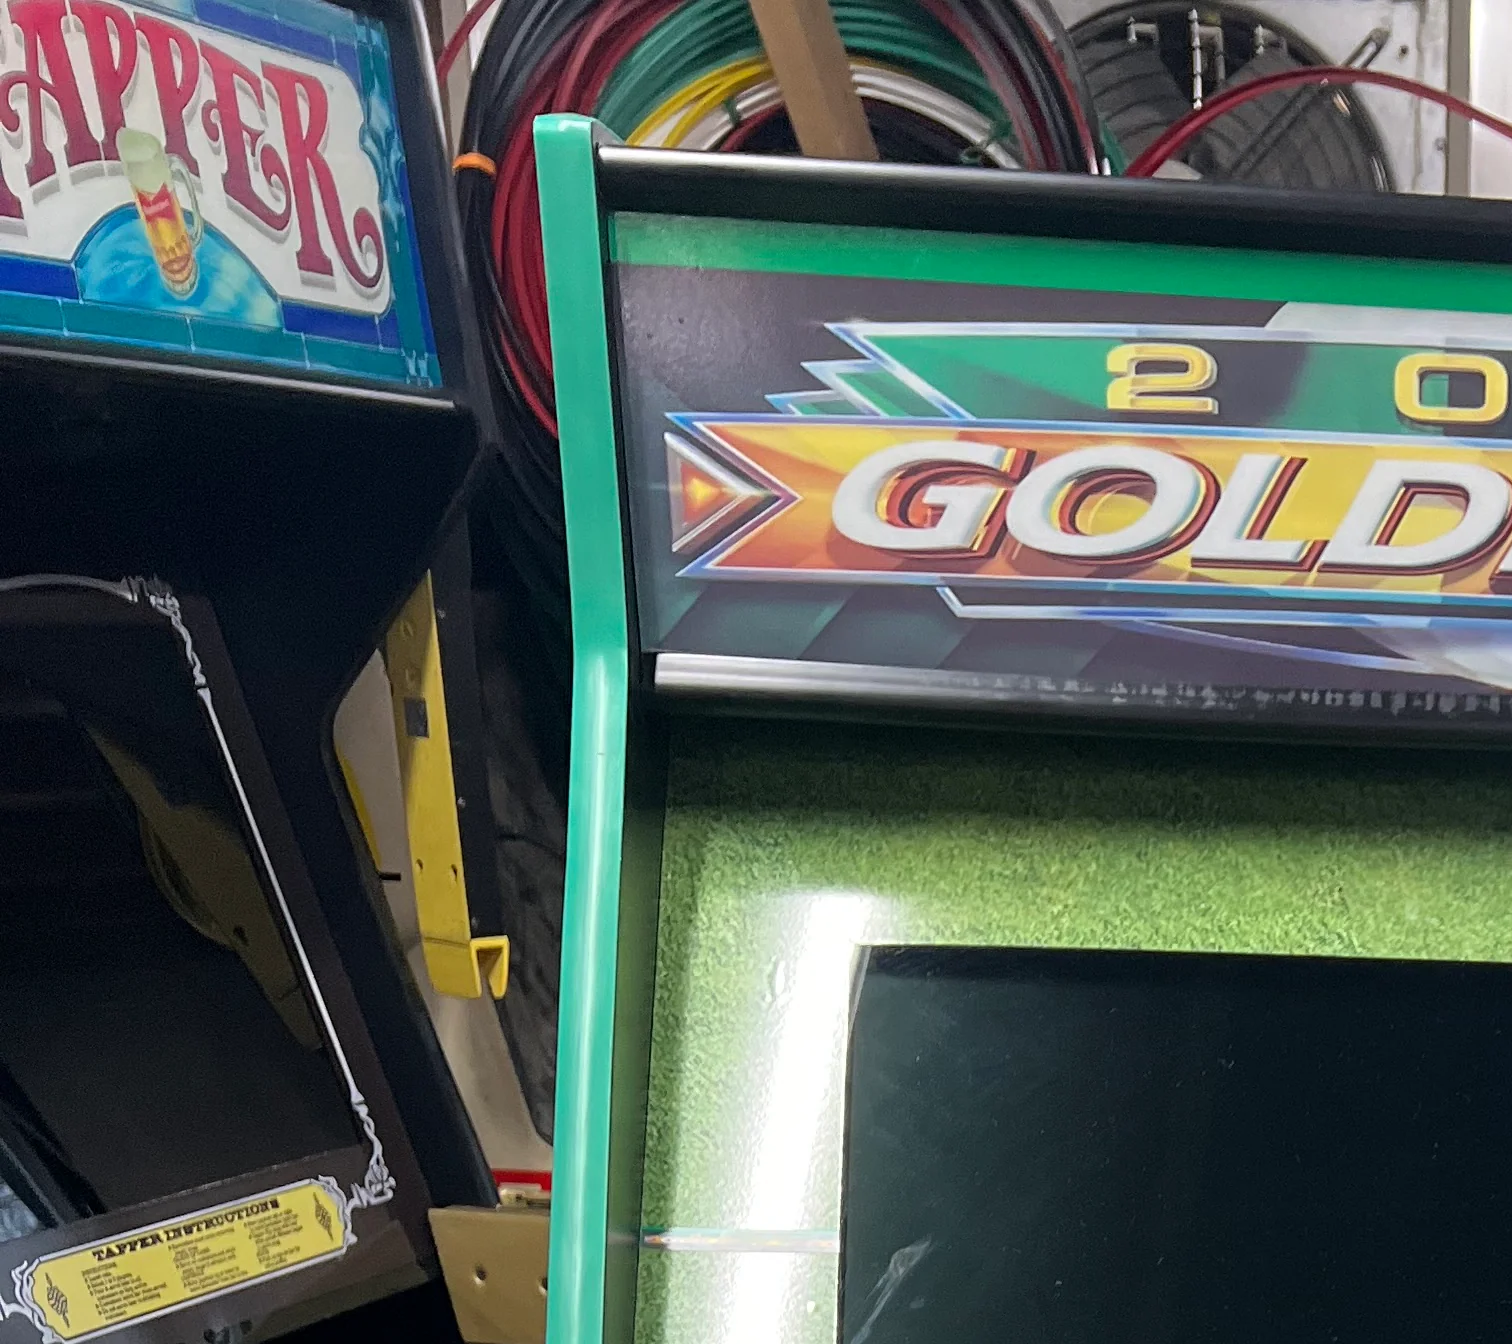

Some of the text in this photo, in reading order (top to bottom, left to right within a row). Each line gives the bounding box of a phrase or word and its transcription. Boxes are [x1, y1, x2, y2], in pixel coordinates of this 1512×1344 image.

[0, 0, 386, 290] APPER
[92, 1198, 280, 1262] TAPPER INSTRUCTIONS
